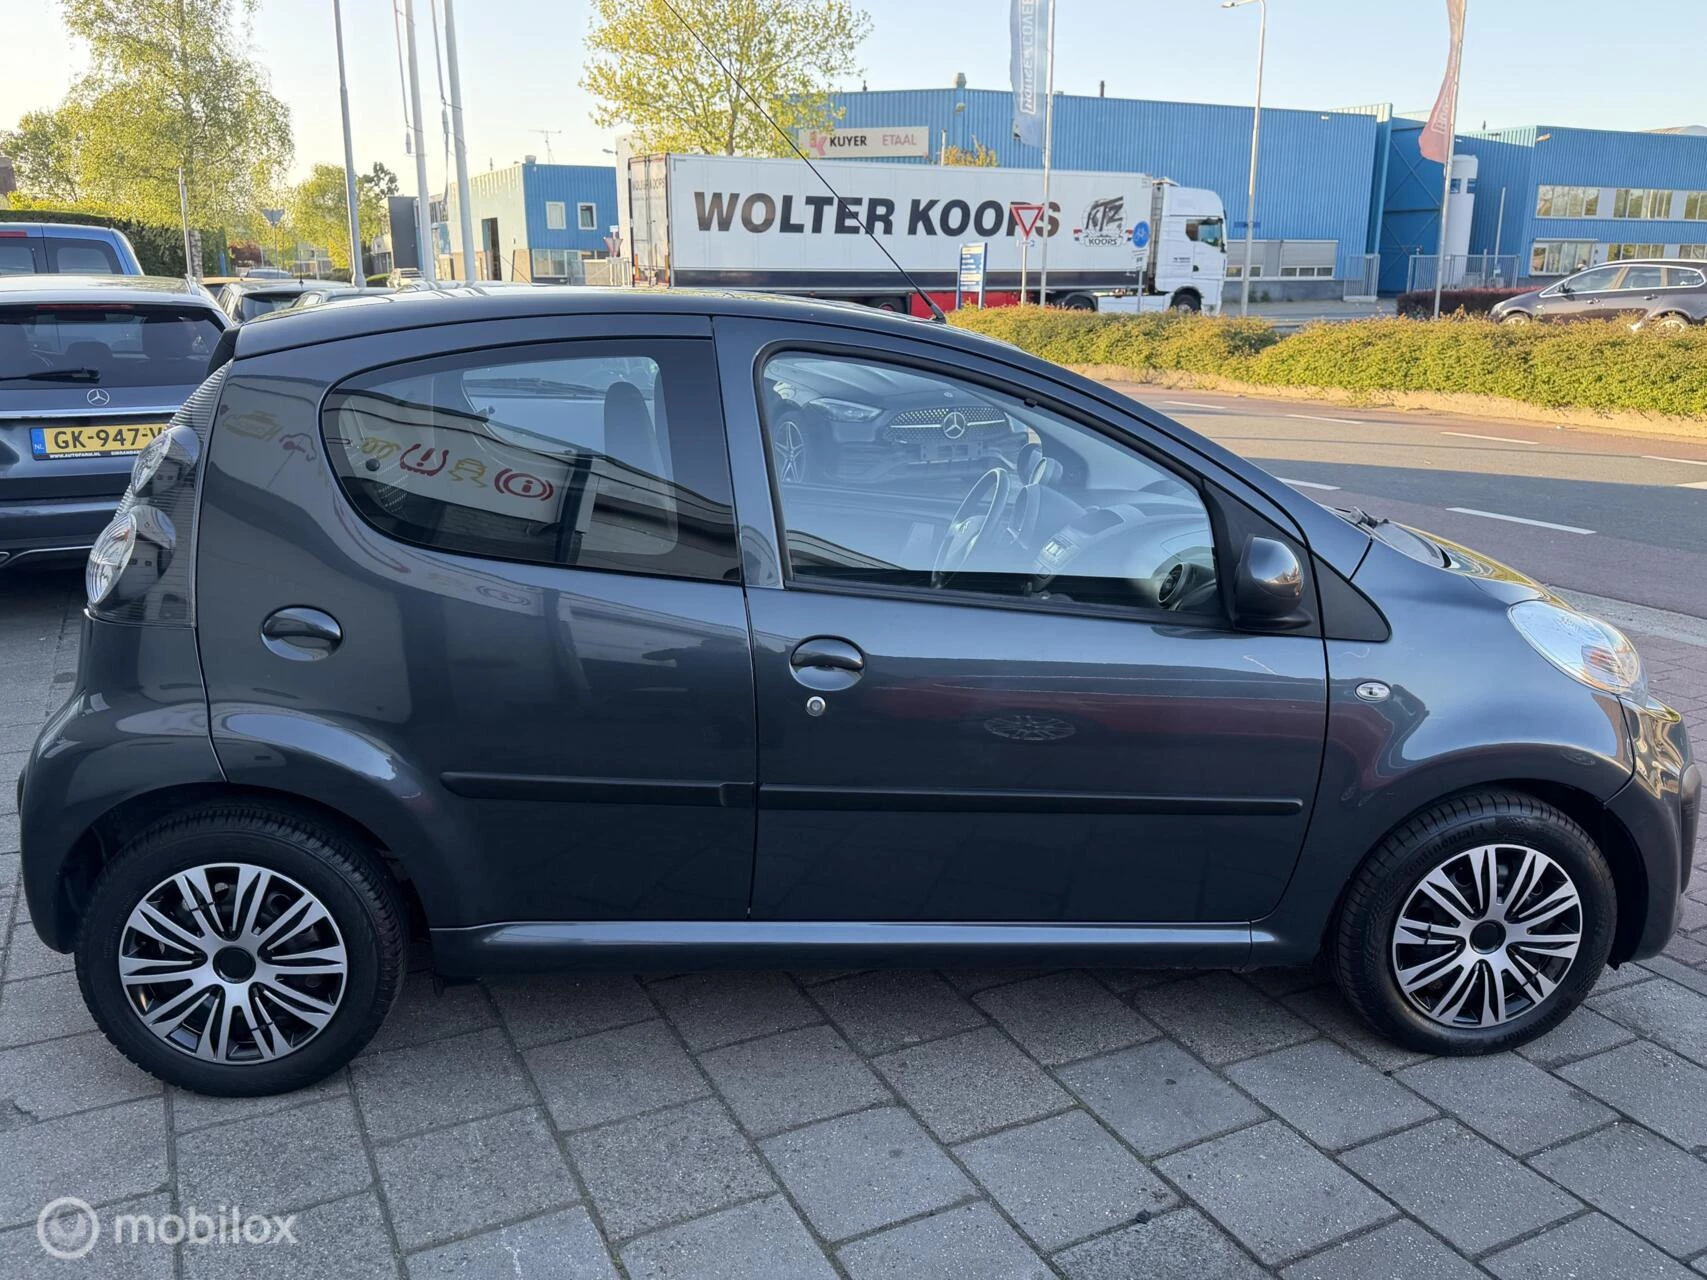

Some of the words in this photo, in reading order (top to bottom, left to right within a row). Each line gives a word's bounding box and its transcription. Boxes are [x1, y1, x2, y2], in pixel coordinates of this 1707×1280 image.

[829, 135, 868, 148] KUYER
[882, 133, 918, 146] ETAAL
[694, 191, 895, 235] WOLTER
[907, 198, 1061, 238] KOOPS
[1088, 237, 1118, 247] KOOPS
